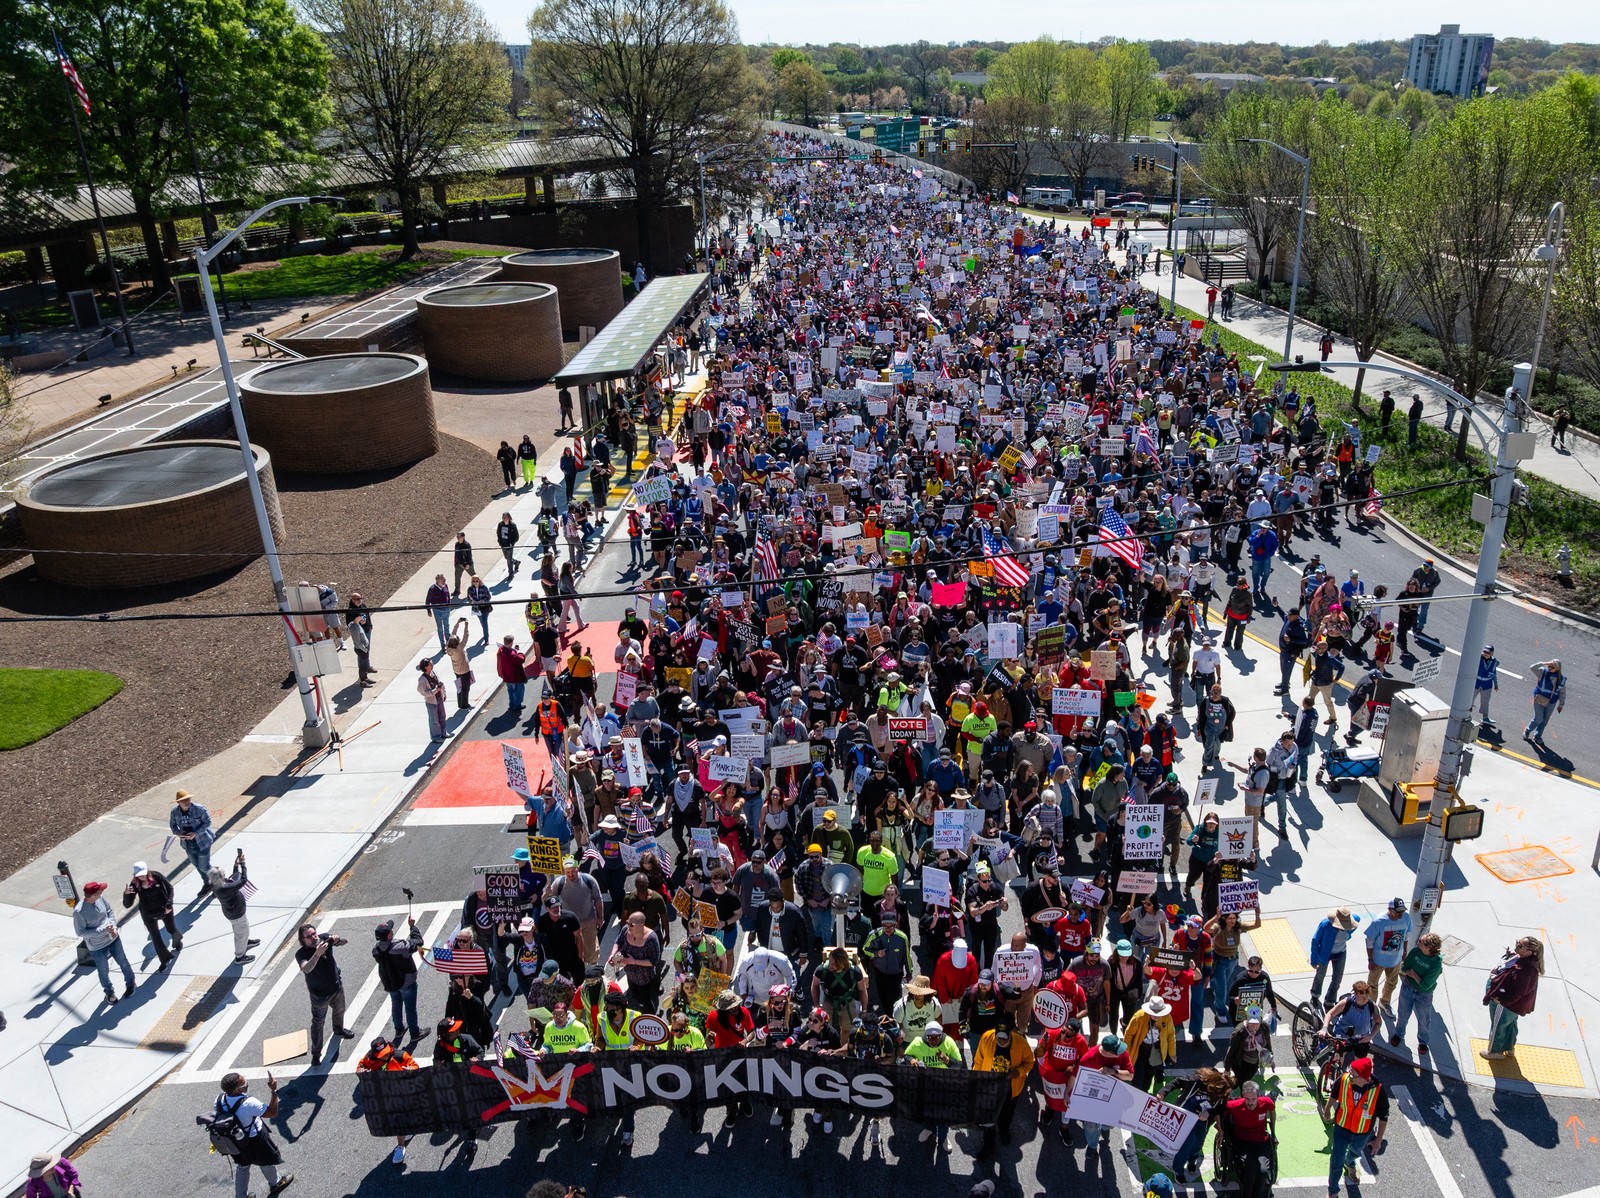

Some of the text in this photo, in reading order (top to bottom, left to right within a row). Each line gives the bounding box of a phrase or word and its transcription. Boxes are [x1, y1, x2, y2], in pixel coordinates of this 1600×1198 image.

[1006, 447, 1021, 459] STOP
[634, 486, 644, 494] NO
[638, 489, 669, 505] TATORS
[822, 580, 842, 593] 250
[773, 598, 785, 609] NO
[730, 619, 752, 631] RESIST
[992, 668, 1012, 687] RESIST
[1053, 689, 1080, 697] TRUMP
[890, 720, 924, 729] VOTE
[891, 730, 915, 738] TODAY!
[1128, 806, 1158, 814] PEOPLE
[1131, 814, 1162, 822] PLANET
[529, 837, 558, 846] NO
[1126, 842, 1155, 850] PROFIT
[1229, 842, 1245, 850] NO
[529, 845, 559, 857] KINGS
[1125, 850, 1162, 859] POWER TRIPS
[532, 860, 562, 871] WARS
[863, 859, 885, 868] UNION
[473, 865, 519, 876] WHO WOULD
[487, 875, 519, 888] GOOD
[487, 887, 518, 896] CAN WIN
[1220, 881, 1258, 894] DEMOCRACY
[497, 897, 514, 906] be it
[1220, 891, 1259, 904] NEEDS YOUR
[487, 904, 507, 913] believe
[1221, 901, 1257, 912] COURAGE
[490, 913, 505, 923] fight
[1064, 934, 1082, 947] 23
[997, 953, 1034, 961] Fuck Trump
[1158, 951, 1176, 959] SILENCE
[1154, 957, 1185, 967] COMPLIANCE
[1000, 973, 1029, 981] Fascist
[1161, 986, 1182, 1001] 23
[1035, 995, 1065, 1017] UNITE
[910, 1011, 926, 1020] POWER
[1034, 1004, 1063, 1025] HERE!
[638, 1024, 662, 1032] UNITE
[550, 1034, 576, 1043] UNION
[638, 1030, 662, 1038] HERE!
[1055, 1044, 1076, 1053] UNITE
[1053, 1050, 1076, 1061] HERE!
[380, 1072, 454, 1096] KINGS NO
[601, 1057, 895, 1108] NO KINGS
[434, 1089, 457, 1106] NO
[1147, 1099, 1185, 1125] FUN
[1142, 1112, 1177, 1135] UNIONISTS
[1144, 1108, 1180, 1130] FEDERAL
[1140, 1117, 1175, 1139] NETWORK
